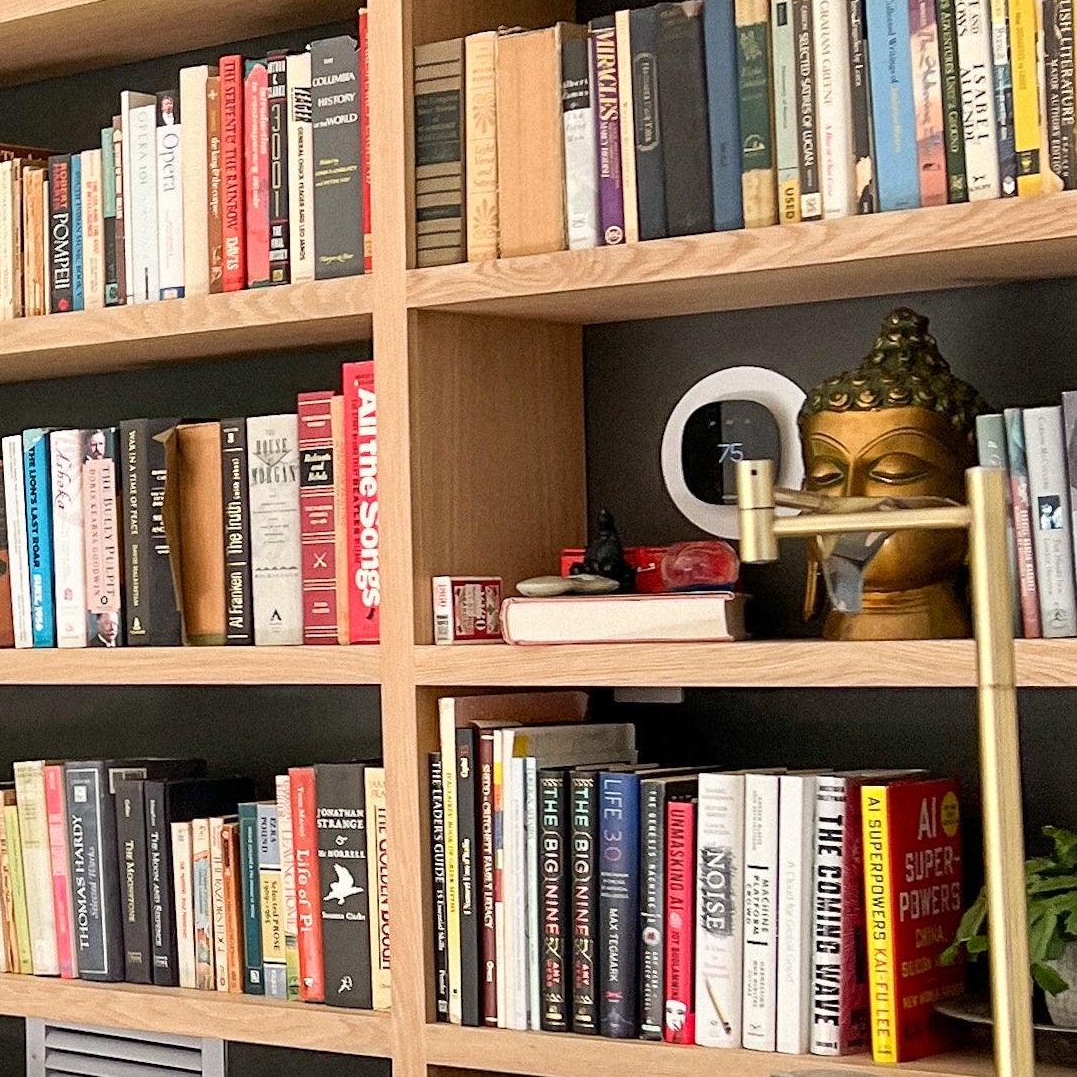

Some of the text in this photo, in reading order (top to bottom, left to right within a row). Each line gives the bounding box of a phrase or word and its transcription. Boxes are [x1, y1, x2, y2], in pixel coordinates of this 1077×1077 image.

[971, 12, 981, 34] AND
[312, 72, 355, 87] COLUMBIA
[595, 31, 619, 121] MIRACLES
[819, 0, 833, 107] GRAHAM GREENE
[885, 37, 899, 84] Writings of
[1061, 37, 1075, 125] LITERATURE
[249, 81, 261, 173] to contemporary
[317, 93, 356, 107] HISTORY
[325, 113, 358, 125] WORLD
[799, 32, 812, 167] SELECTED SATIRES OF LUCIAN
[973, 63, 989, 141] ISABEL
[1050, 59, 1061, 137] MAJOR AUTHORS
[59, 161, 68, 209] ROBERT
[159, 133, 180, 193] Opera
[223, 61, 241, 271] THE SERPENT THE RAINBOW DAVIS
[785, 187, 796, 219] USED
[53, 212, 69, 290] POMPEII
[128, 429, 137, 451] WAR
[129, 452, 137, 465] IN
[255, 439, 289, 453] HOUSE
[717, 443, 745, 464] 75
[55, 443, 71, 510] Ashoka
[129, 473, 137, 495] TIME
[129, 497, 138, 508] OF
[251, 465, 297, 486] MORGAN
[355, 387, 381, 607] All Songs
[27, 446, 41, 567] THE LION'S LAST ROAR
[89, 467, 101, 596] DORIS KEARNS GOODWIN
[101, 465, 115, 597] THE BULLY PULPIT
[129, 509, 139, 535] PEACE
[229, 532, 243, 555] The
[229, 571, 244, 628] Al Franken
[260, 817, 269, 853] POUND
[269, 817, 277, 843] EZRA
[317, 808, 364, 818] JONATHAN
[317, 819, 364, 829] STRANGE
[431, 761, 446, 882] THE LEADER'S GUIDE
[603, 779, 623, 861] LIFE 3.0
[917, 797, 937, 841] AI
[151, 831, 162, 903] THE MOON AND
[327, 849, 366, 859] NORRELL
[543, 787, 559, 935] THE BIG NINE
[573, 787, 590, 936] THE BIG NINE
[647, 791, 657, 909] THE GENESIS MACHINE
[669, 809, 685, 910] UNMASKING AI
[905, 846, 961, 883] SUPER-
[71, 815, 90, 951] THOMAS HARDY
[125, 840, 135, 922] THE MOONSTONE
[286, 882, 297, 933] HOME
[297, 849, 313, 933] Life of Pi
[705, 849, 725, 931] NOISE
[751, 875, 761, 935] PLATFORM
[761, 879, 769, 933] MACHINE
[899, 882, 961, 923] POWERS
[271, 881, 281, 951] Selected PROSE
[607, 908, 619, 981] MAX TEGMARK
[671, 929, 681, 945] JOY
[815, 815, 843, 1025] THE COMING WAVE
[867, 797, 891, 1037] AI SUPERPOWERS KAI-FU LEE
